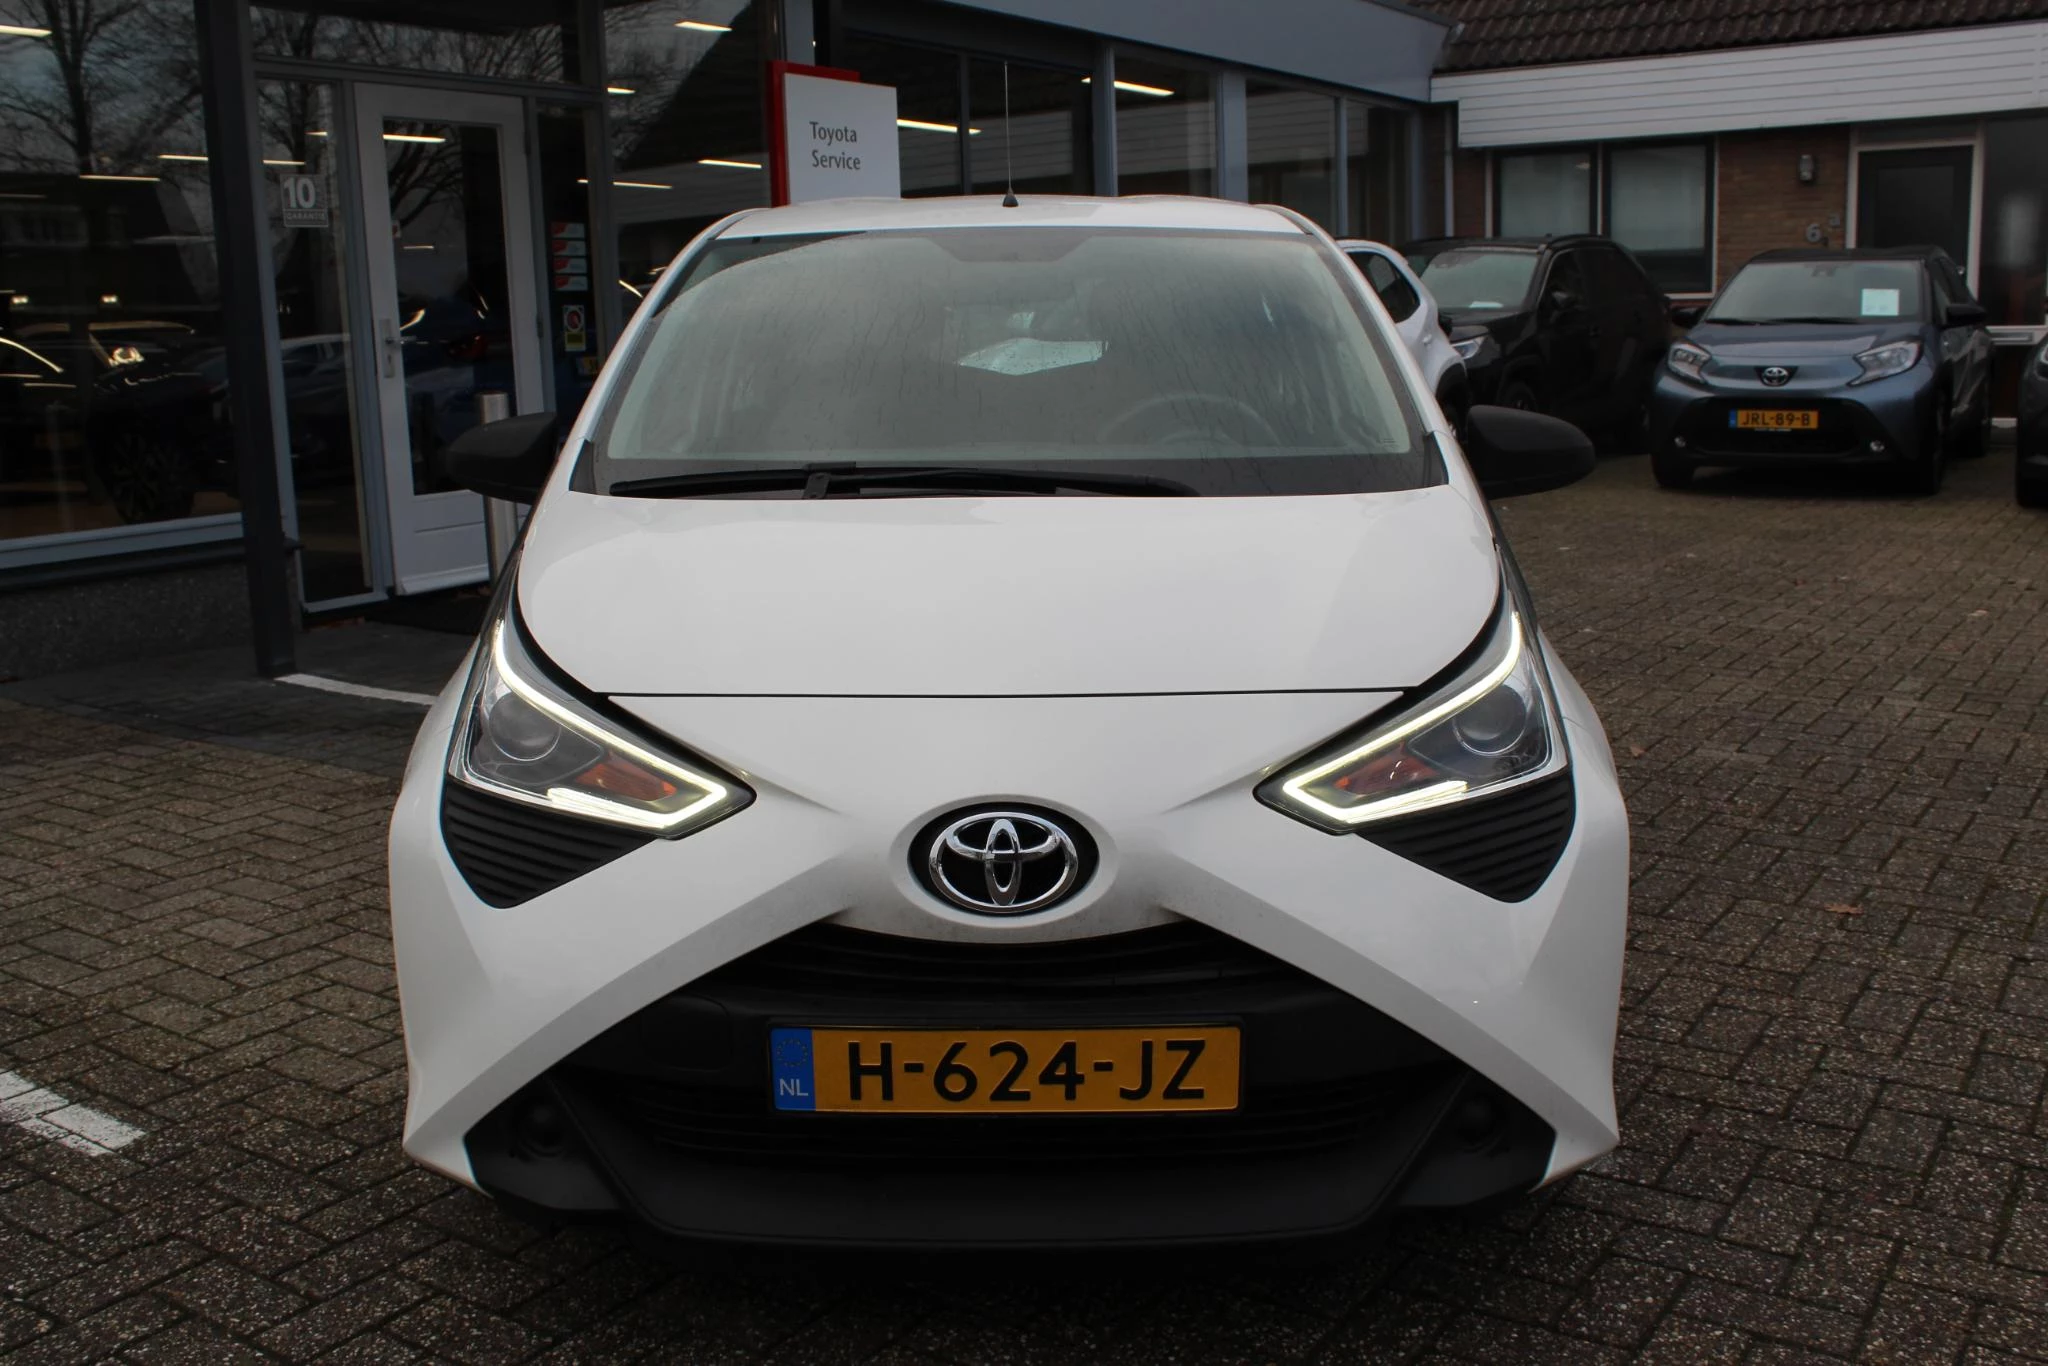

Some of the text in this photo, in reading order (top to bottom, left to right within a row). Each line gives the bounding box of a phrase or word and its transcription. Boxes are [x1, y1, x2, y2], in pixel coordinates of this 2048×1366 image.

[809, 121, 858, 147] Toyota
[811, 149, 862, 171] Service
[284, 178, 316, 208] 10
[1741, 411, 1810, 426] JRL-89-B
[847, 1039, 1206, 1102] H-624-JZ
[779, 1078, 809, 1098] NL
